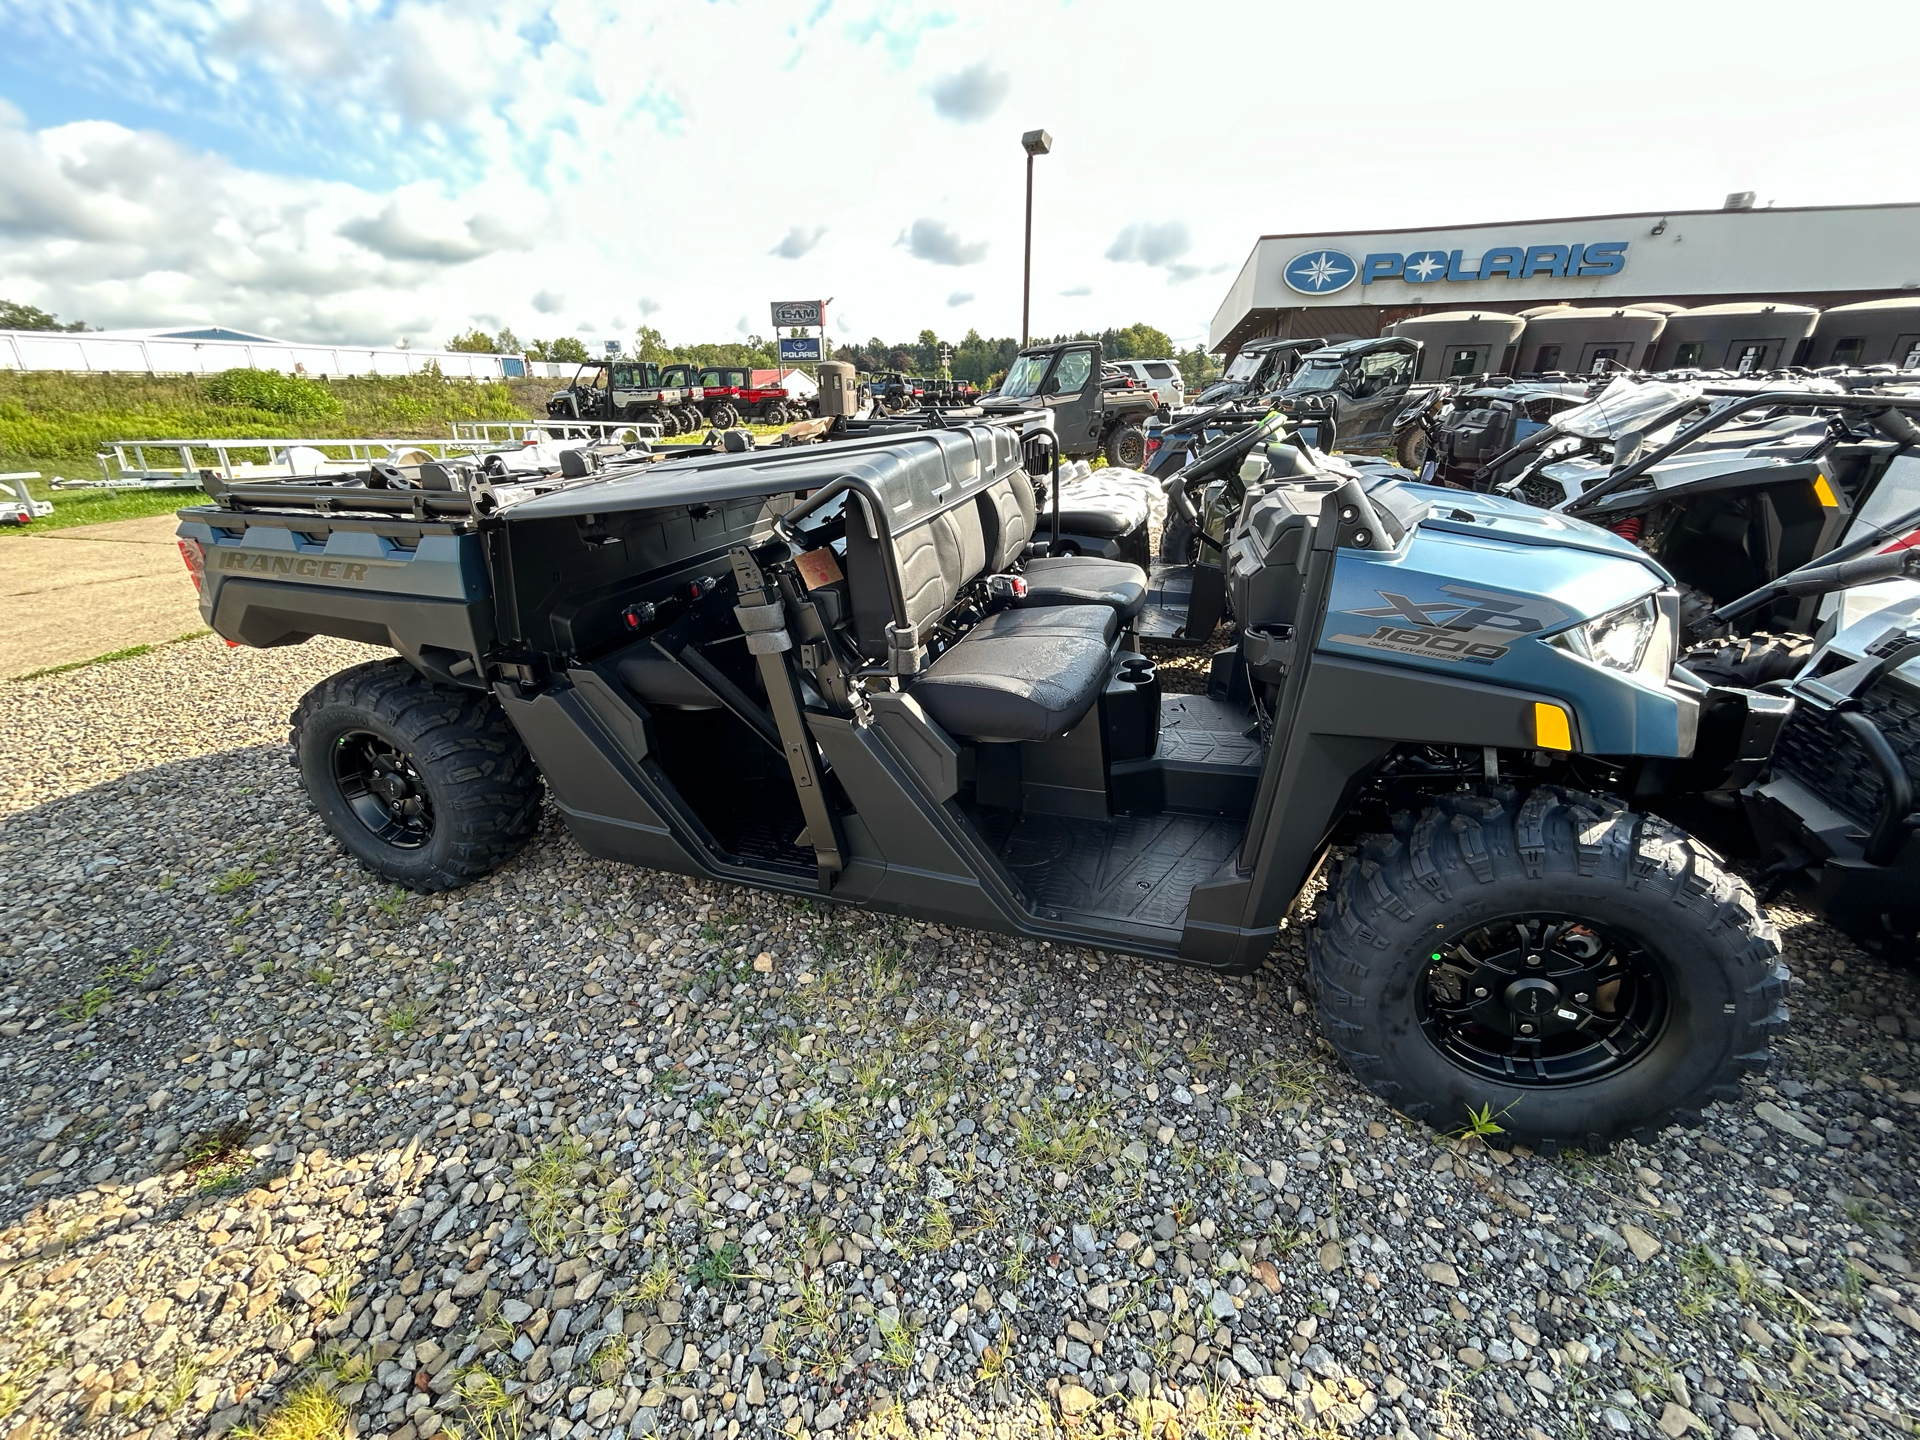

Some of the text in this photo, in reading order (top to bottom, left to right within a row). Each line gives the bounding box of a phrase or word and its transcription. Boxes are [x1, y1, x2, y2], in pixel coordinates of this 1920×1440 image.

[1362, 241, 1630, 285] POLARIS
[219, 551, 370, 582] RANGER
[1367, 641, 1398, 651] DUAL
[1400, 646, 1466, 661] OVERHEAD
[1371, 625, 1511, 660] 1000
